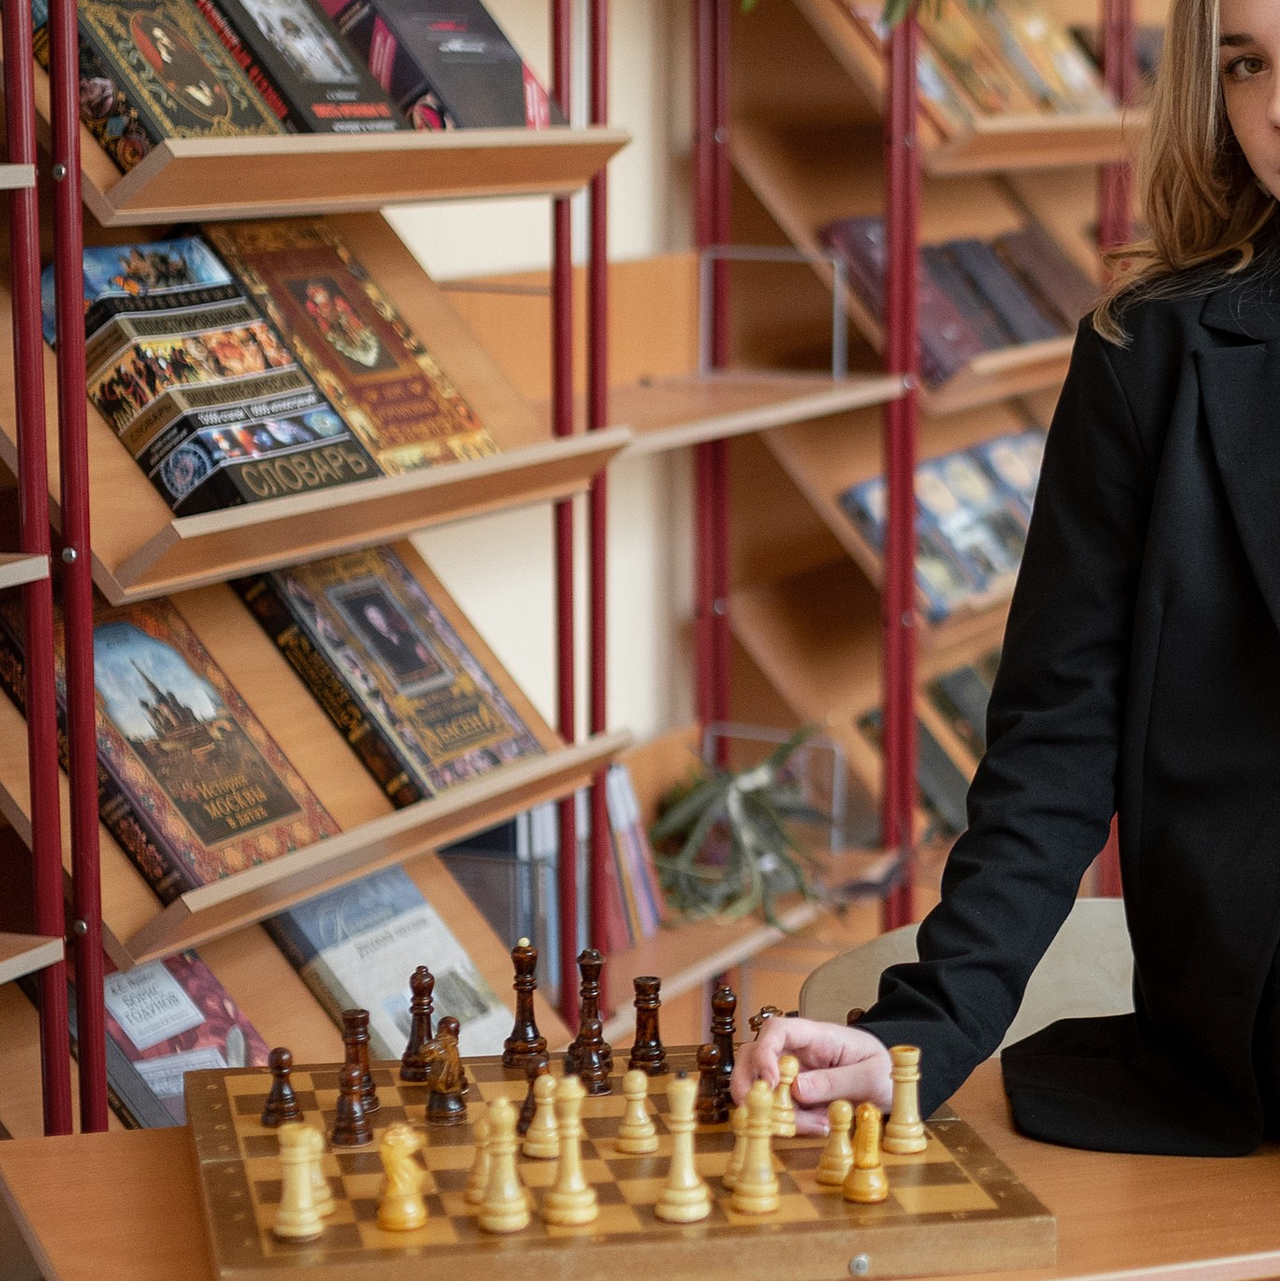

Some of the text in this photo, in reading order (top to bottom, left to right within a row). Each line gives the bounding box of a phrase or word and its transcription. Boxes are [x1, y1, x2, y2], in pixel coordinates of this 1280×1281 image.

[242, 444, 368, 499] СЛОВАРЬ
[204, 785, 268, 819] МОСКВЫ
[122, 981, 160, 1008] БОРИС
[125, 993, 180, 1025] ГОДУНОВ
